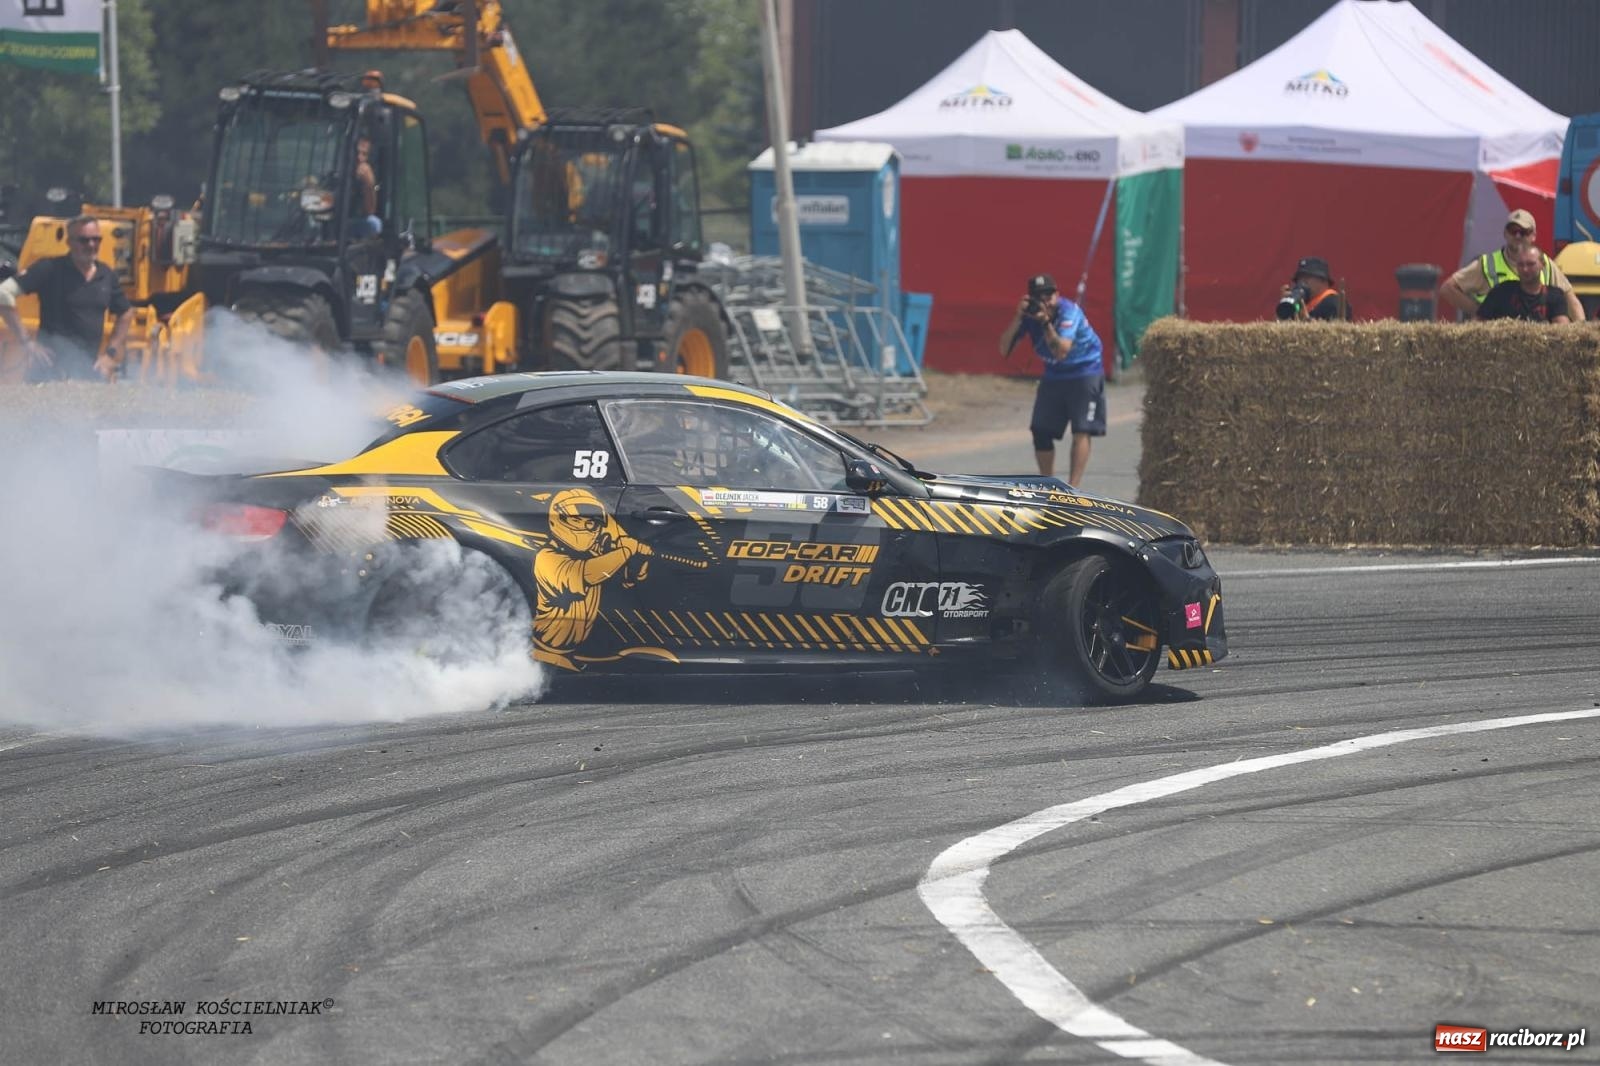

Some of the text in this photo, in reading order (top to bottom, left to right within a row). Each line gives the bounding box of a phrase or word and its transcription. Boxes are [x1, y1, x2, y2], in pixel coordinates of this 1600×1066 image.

[572, 450, 610, 479] 58
[715, 493, 741, 501] OLEJNIK
[813, 496, 829, 510] 58
[730, 541, 863, 562] TOP-CAR
[784, 565, 872, 586] DRIFT
